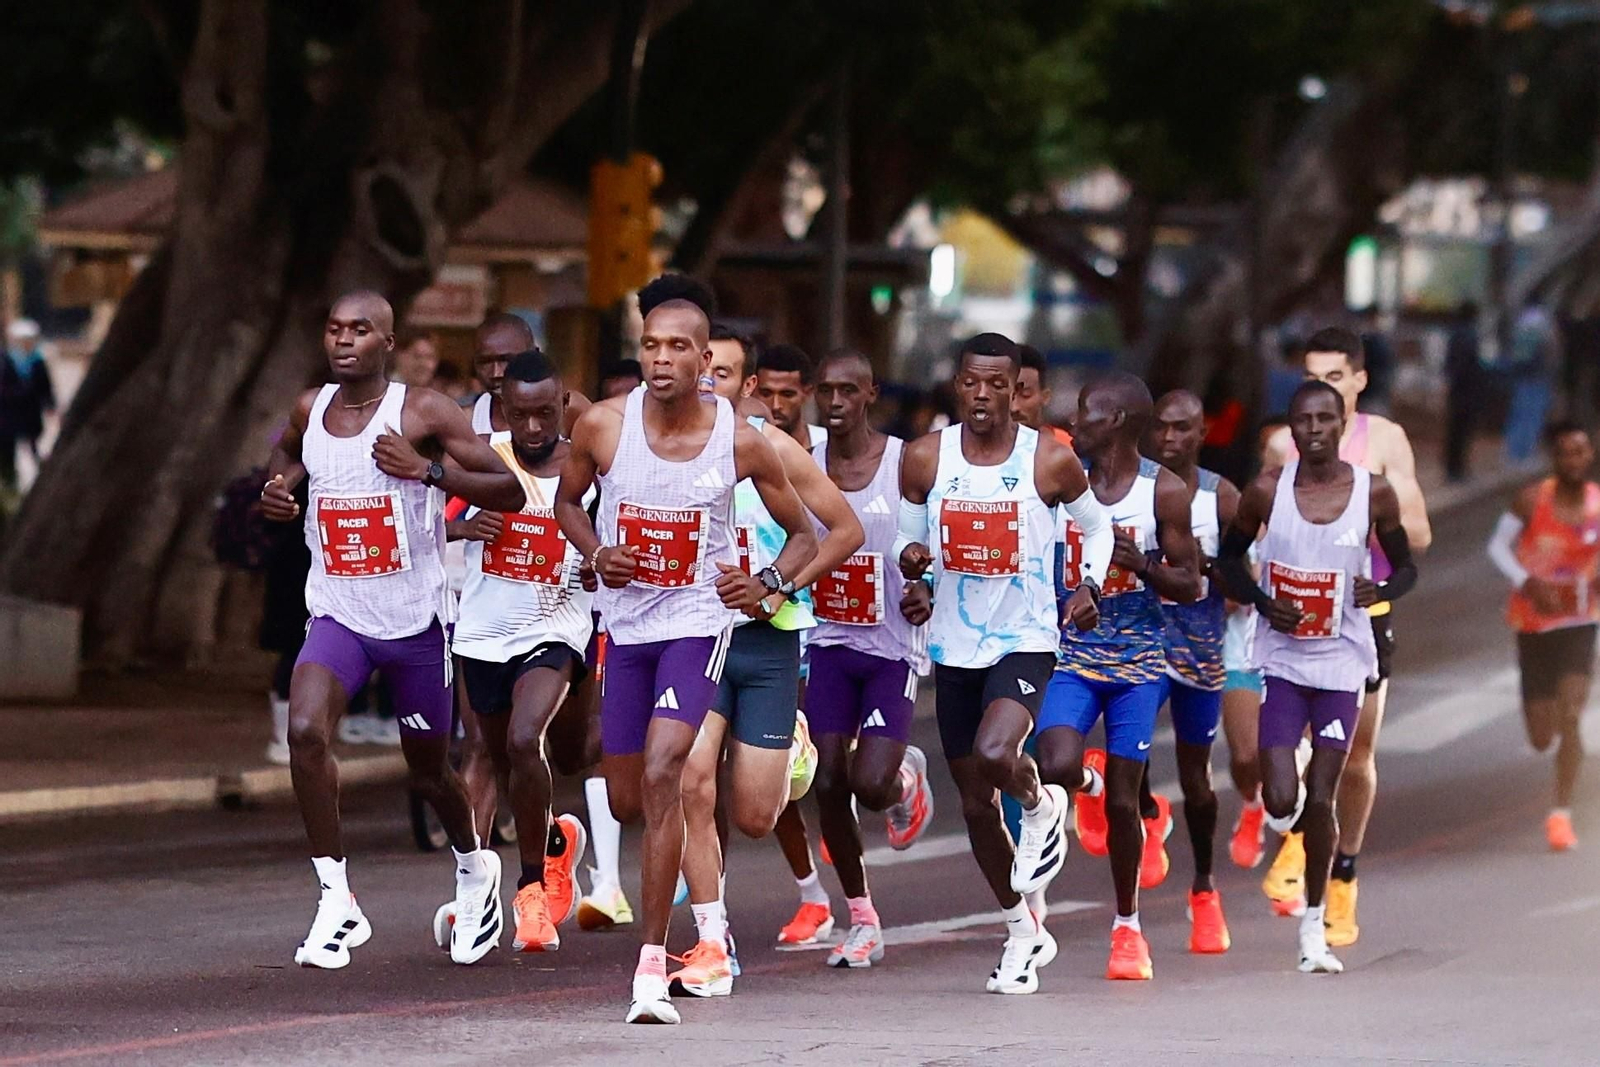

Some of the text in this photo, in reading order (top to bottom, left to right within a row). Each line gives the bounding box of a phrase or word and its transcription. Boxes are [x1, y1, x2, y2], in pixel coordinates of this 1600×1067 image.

[332, 498, 386, 510] GENERALI
[960, 501, 1012, 513] GENERALI
[519, 508, 555, 519] ENERA
[639, 508, 695, 523] GENERALI
[337, 518, 369, 528] PACER
[511, 521, 545, 535] NZIOKI
[972, 520, 985, 530] 25
[347, 533, 362, 543] 22
[641, 527, 674, 540] PACER
[521, 538, 529, 548] 3
[649, 543, 662, 555] 21
[1284, 568, 1331, 582] GENERALI
